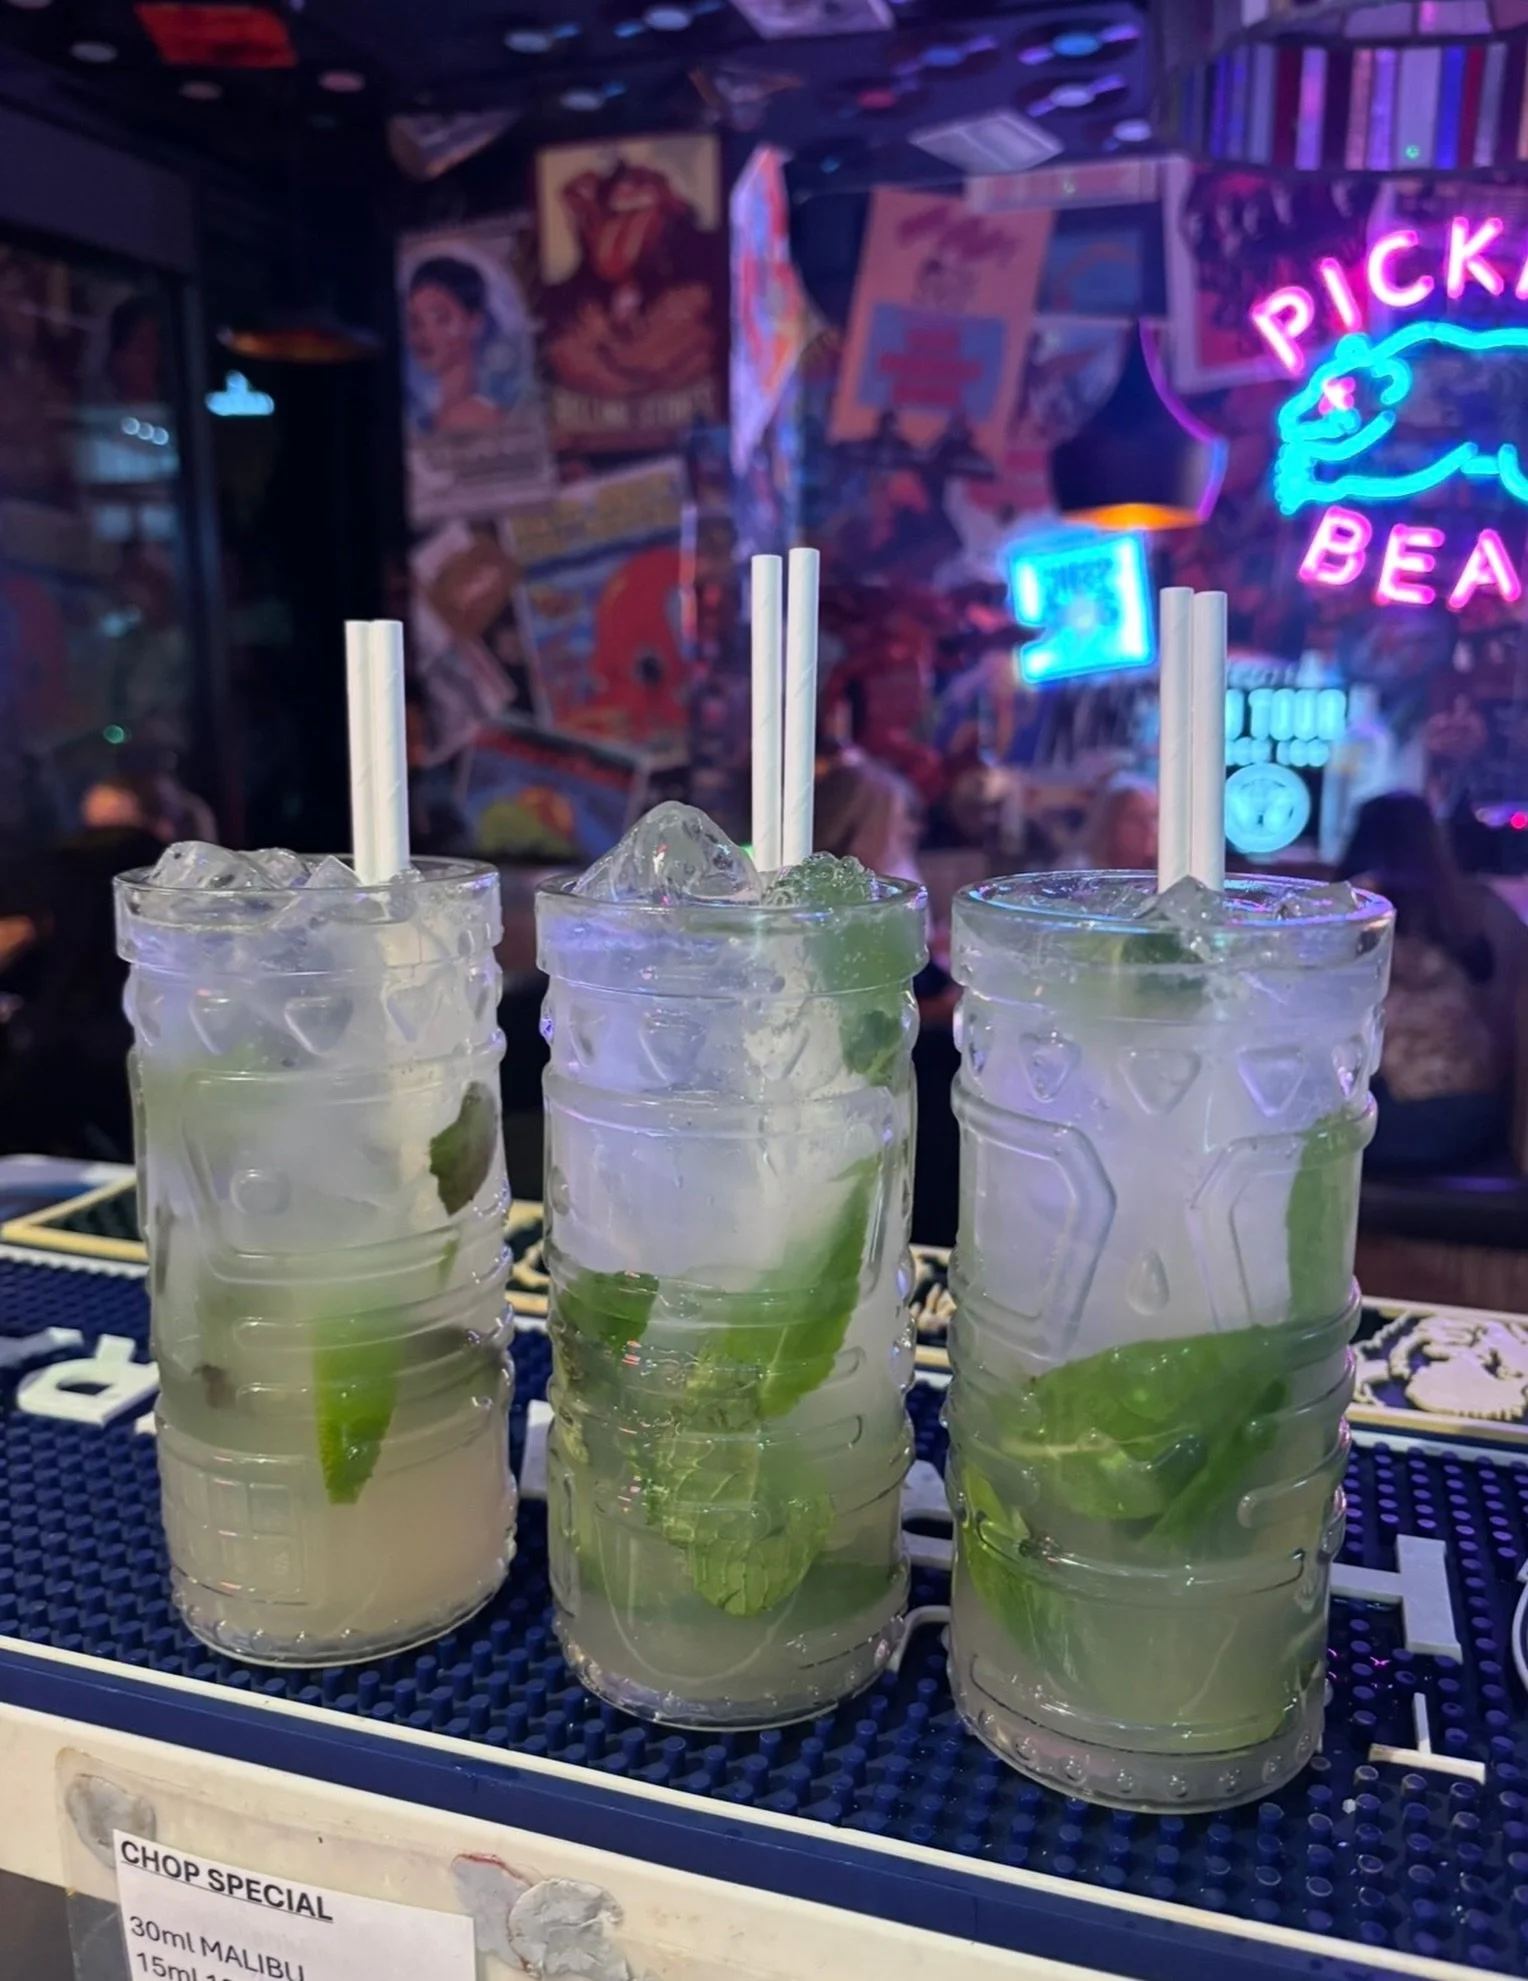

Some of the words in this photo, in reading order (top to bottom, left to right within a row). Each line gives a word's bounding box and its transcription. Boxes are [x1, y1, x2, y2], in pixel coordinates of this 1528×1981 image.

[1250, 216, 1528, 374] PICK
[120, 1840, 200, 1882] CHOP
[207, 1868, 333, 1922] SPECIAL
[130, 1916, 195, 1953] 30ml
[200, 1935, 304, 1981] MALIBU
[137, 1952, 197, 1981] 15ml
